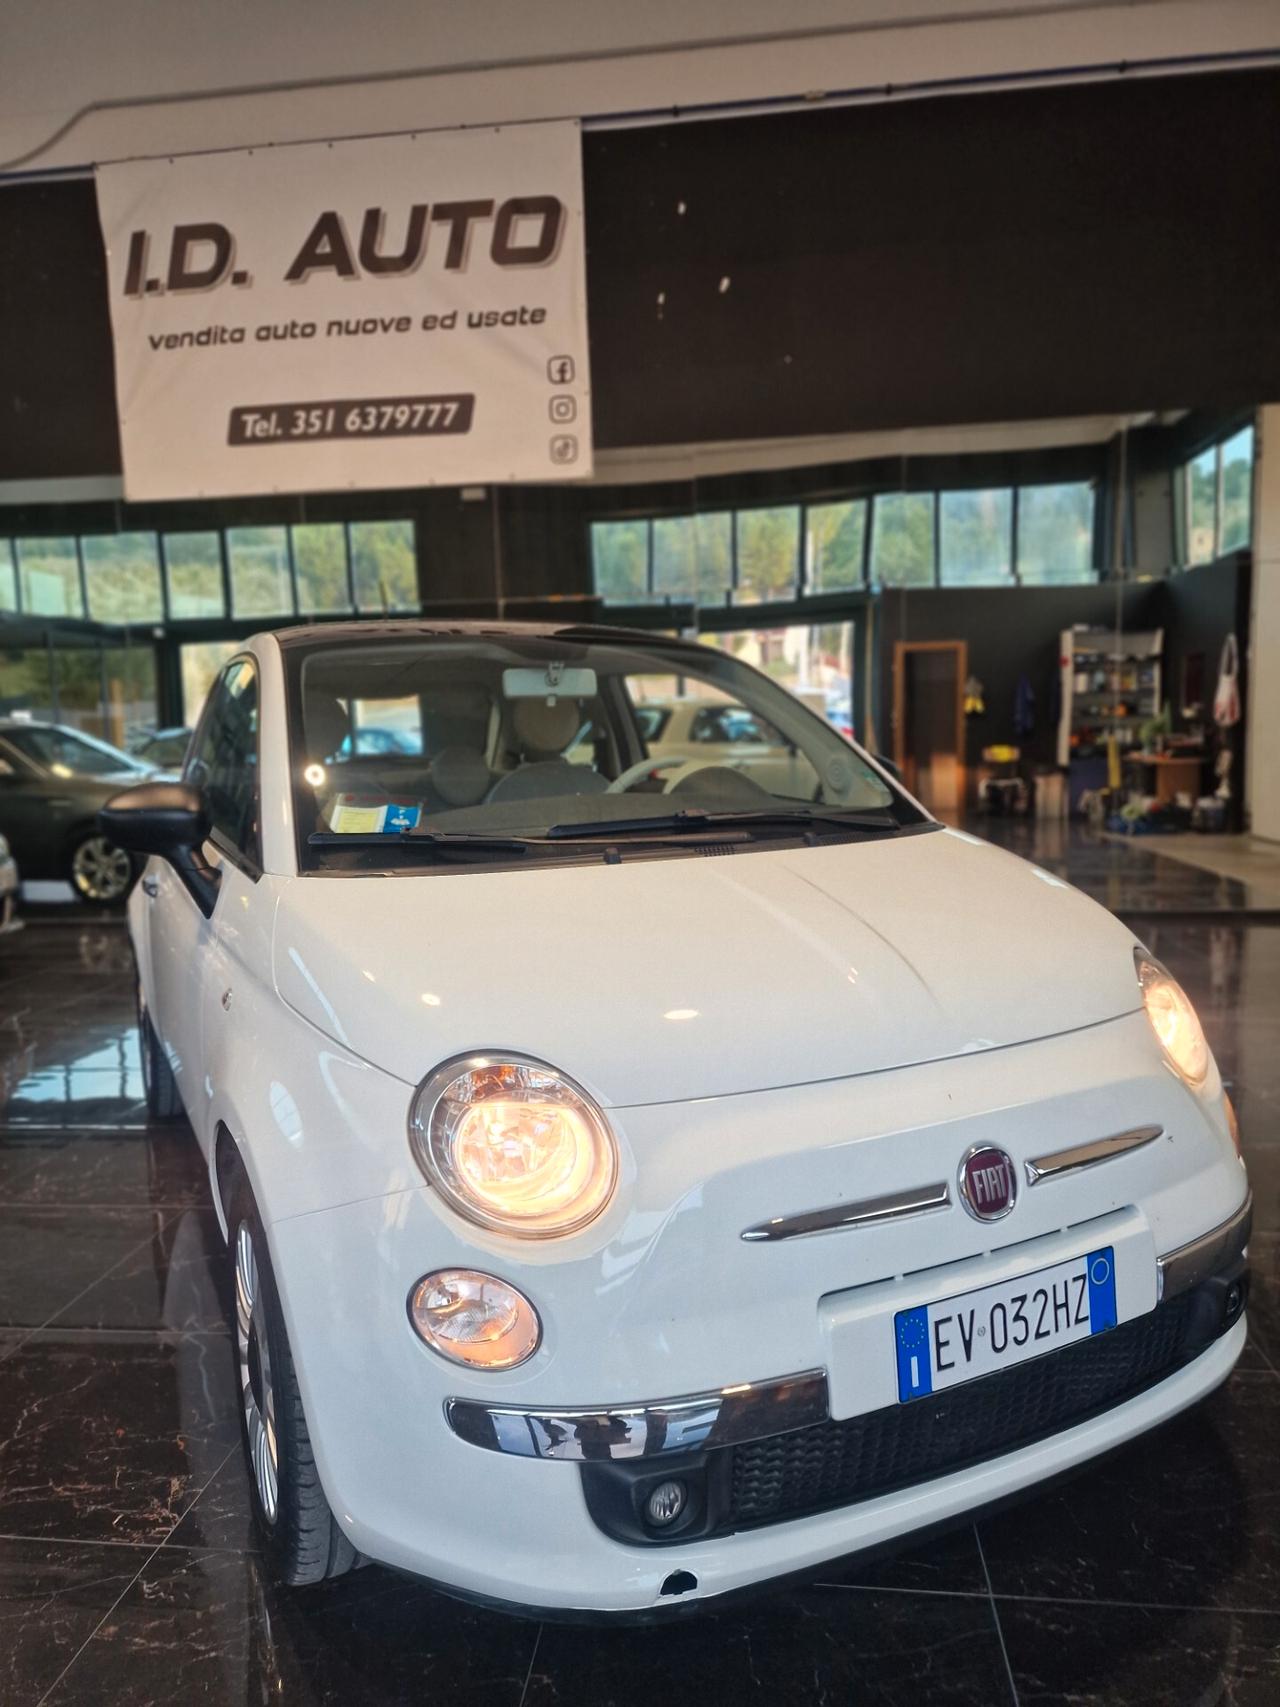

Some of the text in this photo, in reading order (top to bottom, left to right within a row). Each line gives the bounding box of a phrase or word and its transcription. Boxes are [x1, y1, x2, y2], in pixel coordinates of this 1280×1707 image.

[123, 195, 567, 300] I.D. AUTO
[148, 305, 547, 351] vendita auto nuove ed usate
[241, 402, 460, 438] Tel. 351 6379777
[971, 1163, 1005, 1205] FIAT
